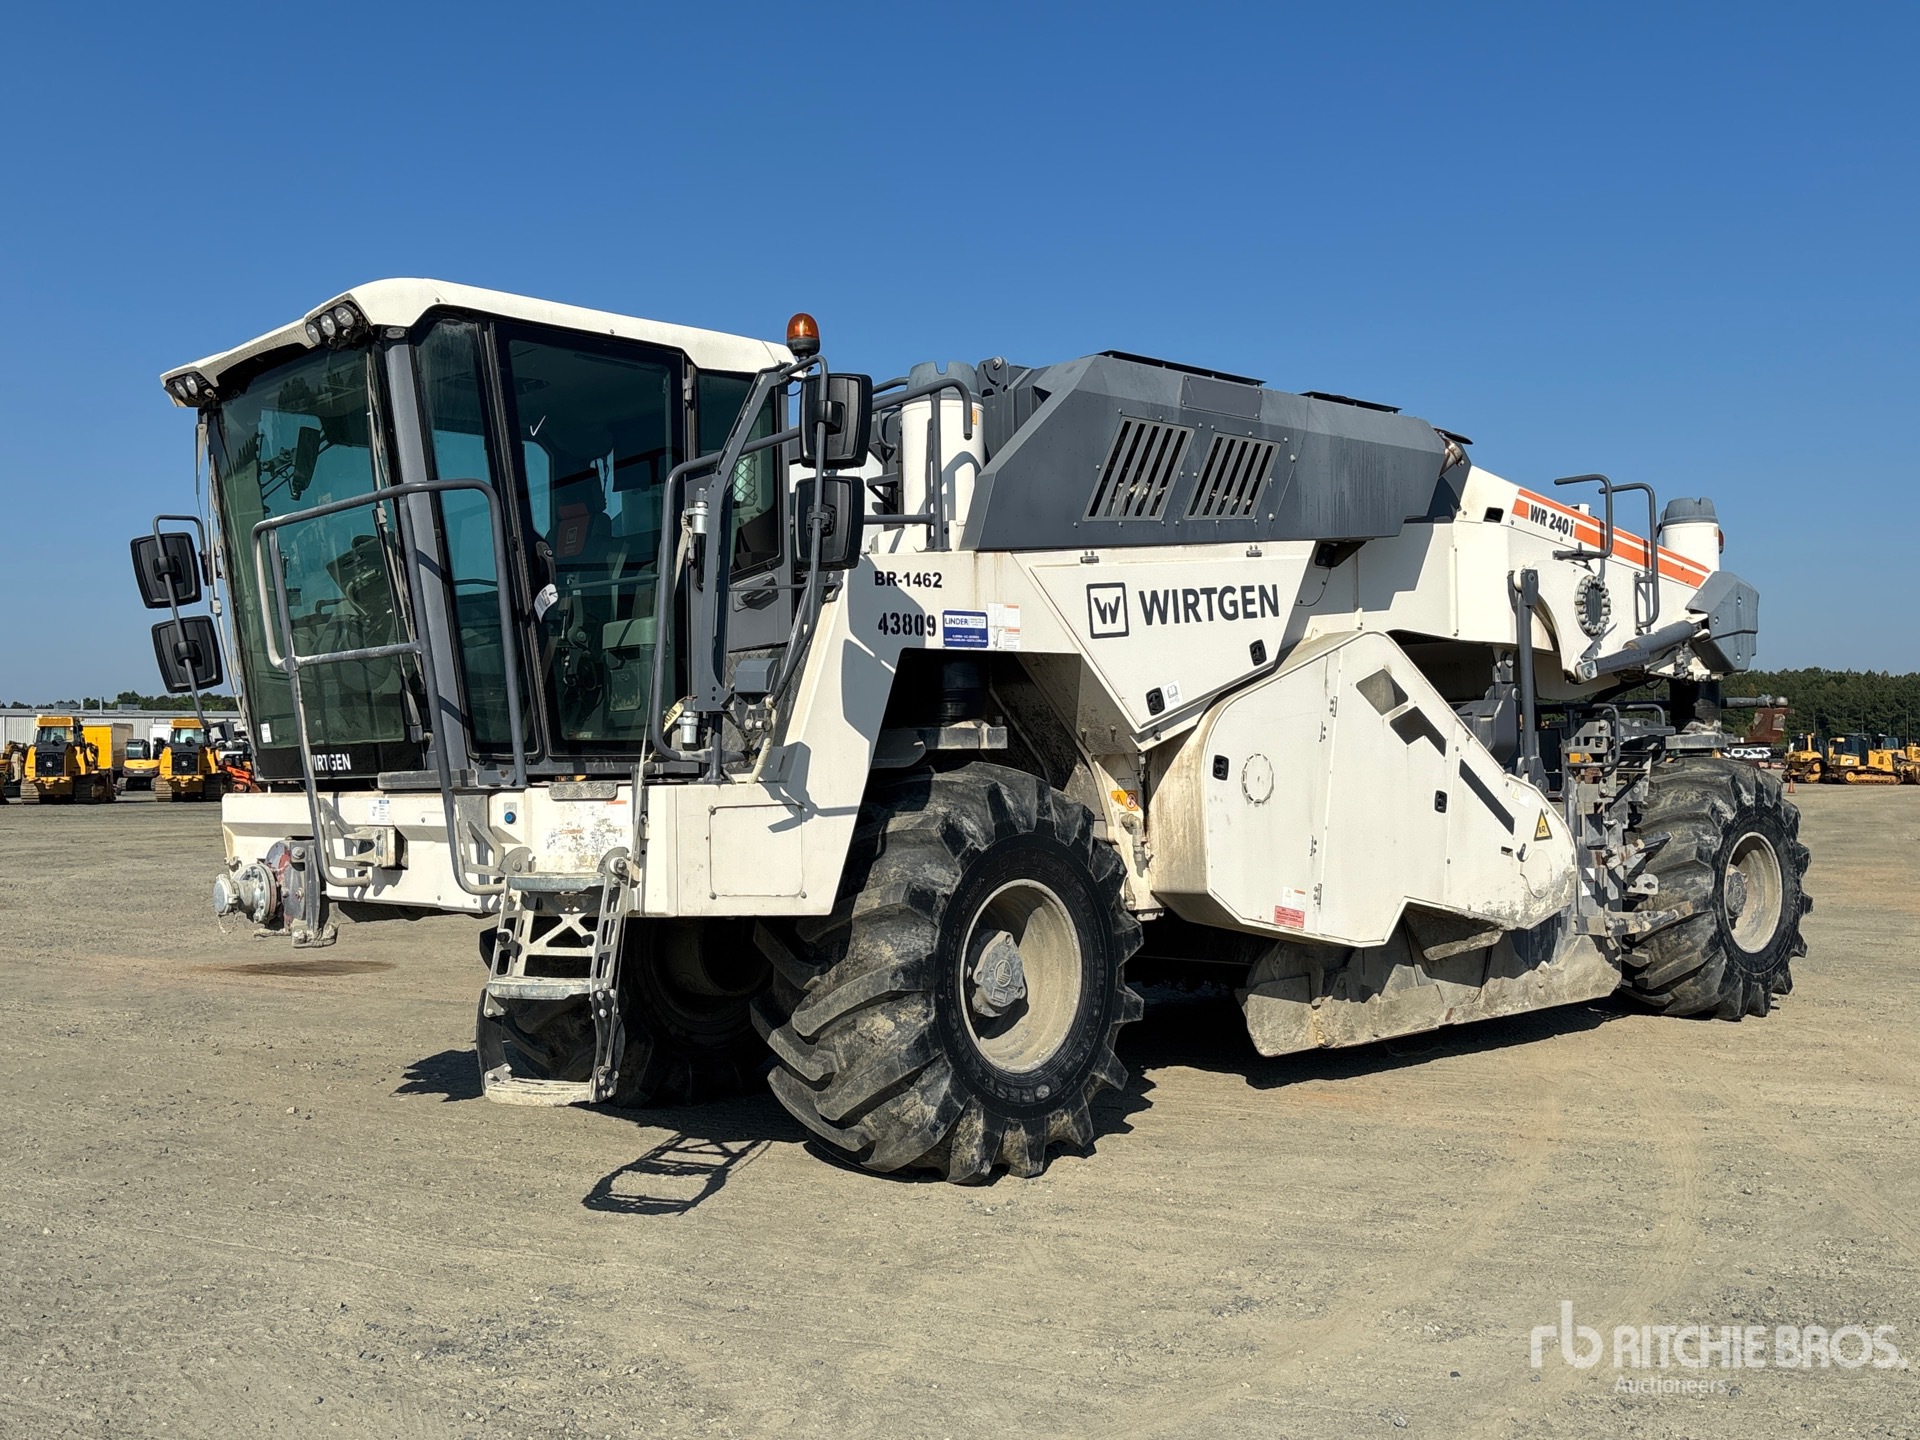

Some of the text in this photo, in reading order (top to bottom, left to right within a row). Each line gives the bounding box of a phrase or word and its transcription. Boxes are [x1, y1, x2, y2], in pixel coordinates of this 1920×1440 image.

[1530, 504, 1548, 527] WR
[874, 570, 943, 589] BR-1462
[1138, 584, 1280, 626] WIRTGEN
[877, 612, 937, 637] 43809
[945, 616, 969, 626] LINDER
[311, 753, 352, 772] IRTGEN
